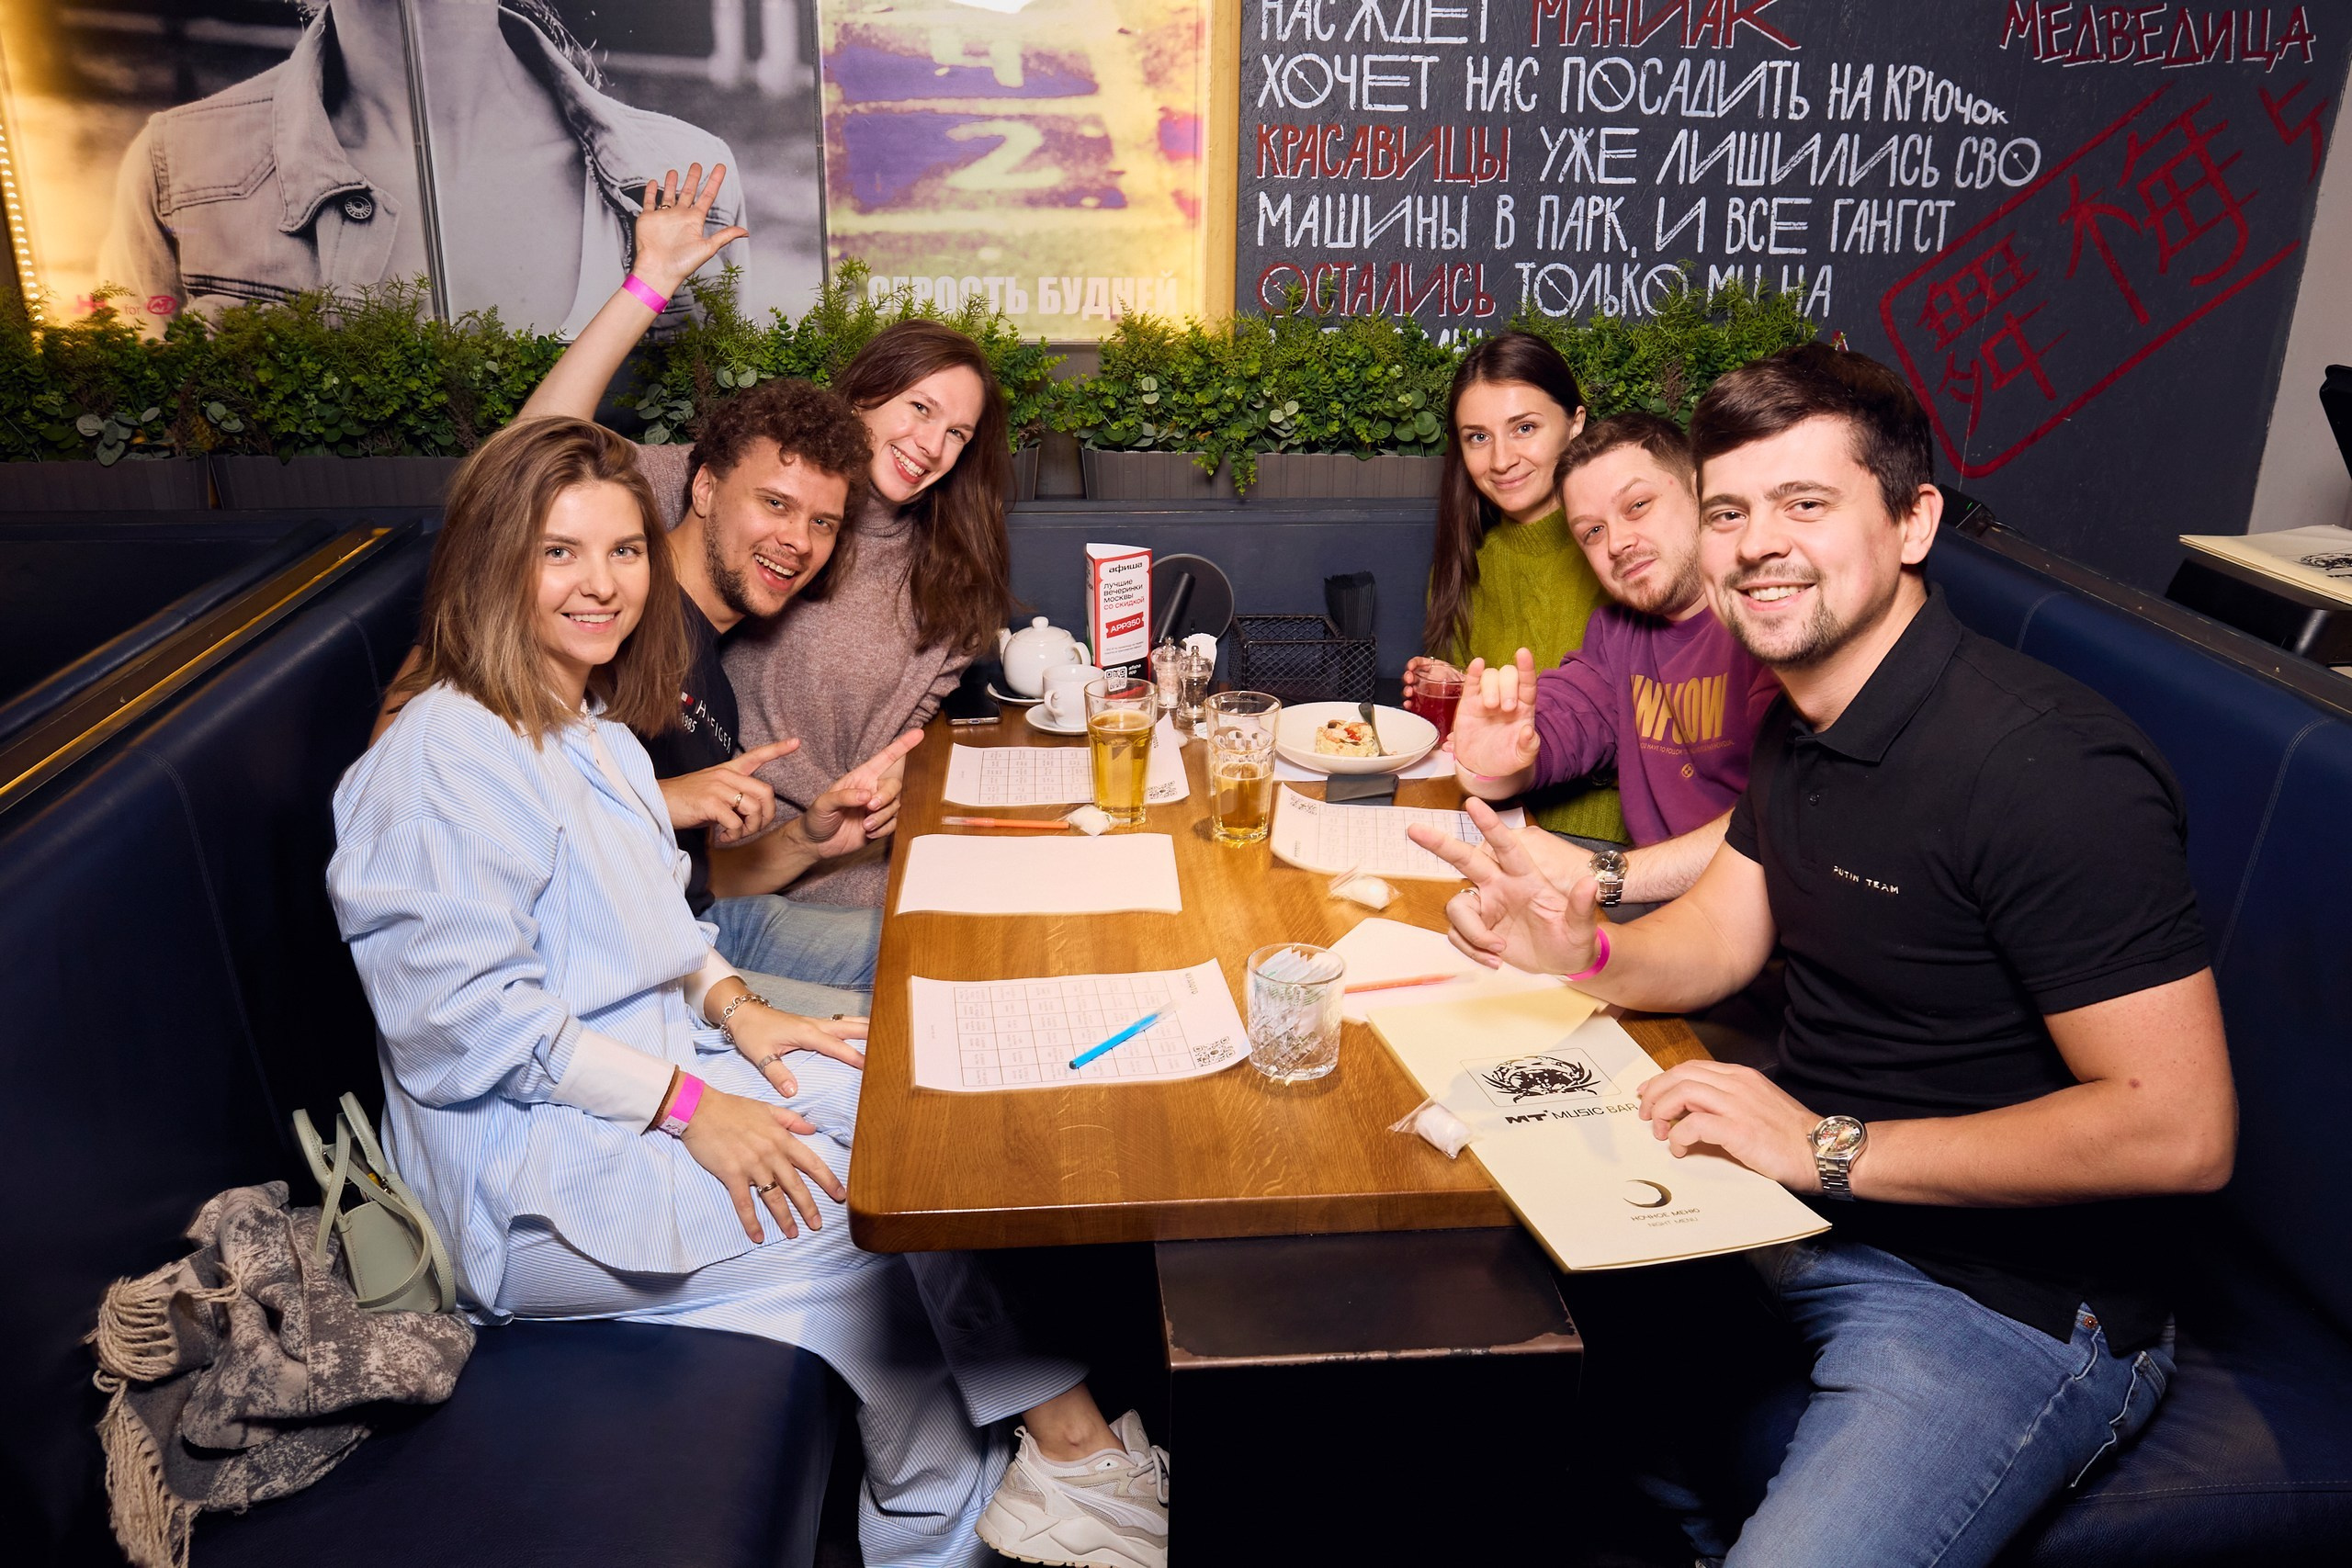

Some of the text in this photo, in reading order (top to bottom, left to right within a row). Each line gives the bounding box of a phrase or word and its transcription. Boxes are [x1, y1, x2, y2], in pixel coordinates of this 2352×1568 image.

[1532, 0, 1801, 50] МАНИАК
[1999, 0, 2316, 73] МЕДВЕДИЦА
[1258, 52, 1440, 111] ХОЧЕТ
[1467, 56, 1540, 112] НАС
[1562, 56, 1810, 120] ПОСАДИТЬ
[1827, 63, 1873, 121] НА
[1256, 124, 2041, 188] КРАСАВИЦЫ УЖЕ ЛИШИЛИСЬ СВО
[1257, 191, 1955, 258] МАШИНЫ В ПАРК, И ВСЕ ГАНГСТ
[124, 304, 141, 315] for
[1038, 269, 1178, 321] БУДНЕЙ
[1256, 261, 1498, 319] ОСТАЛИСЬ
[1514, 261, 1689, 318] ТОЛЬКО
[1780, 264, 1833, 318] НА
[1108, 561, 1143, 574] афиша
[1110, 617, 1141, 634] APP350
[1865, 878, 1899, 895] TEAM
[1551, 1107, 1605, 1120] MUSIC
[1606, 1102, 1639, 1113] BAR
